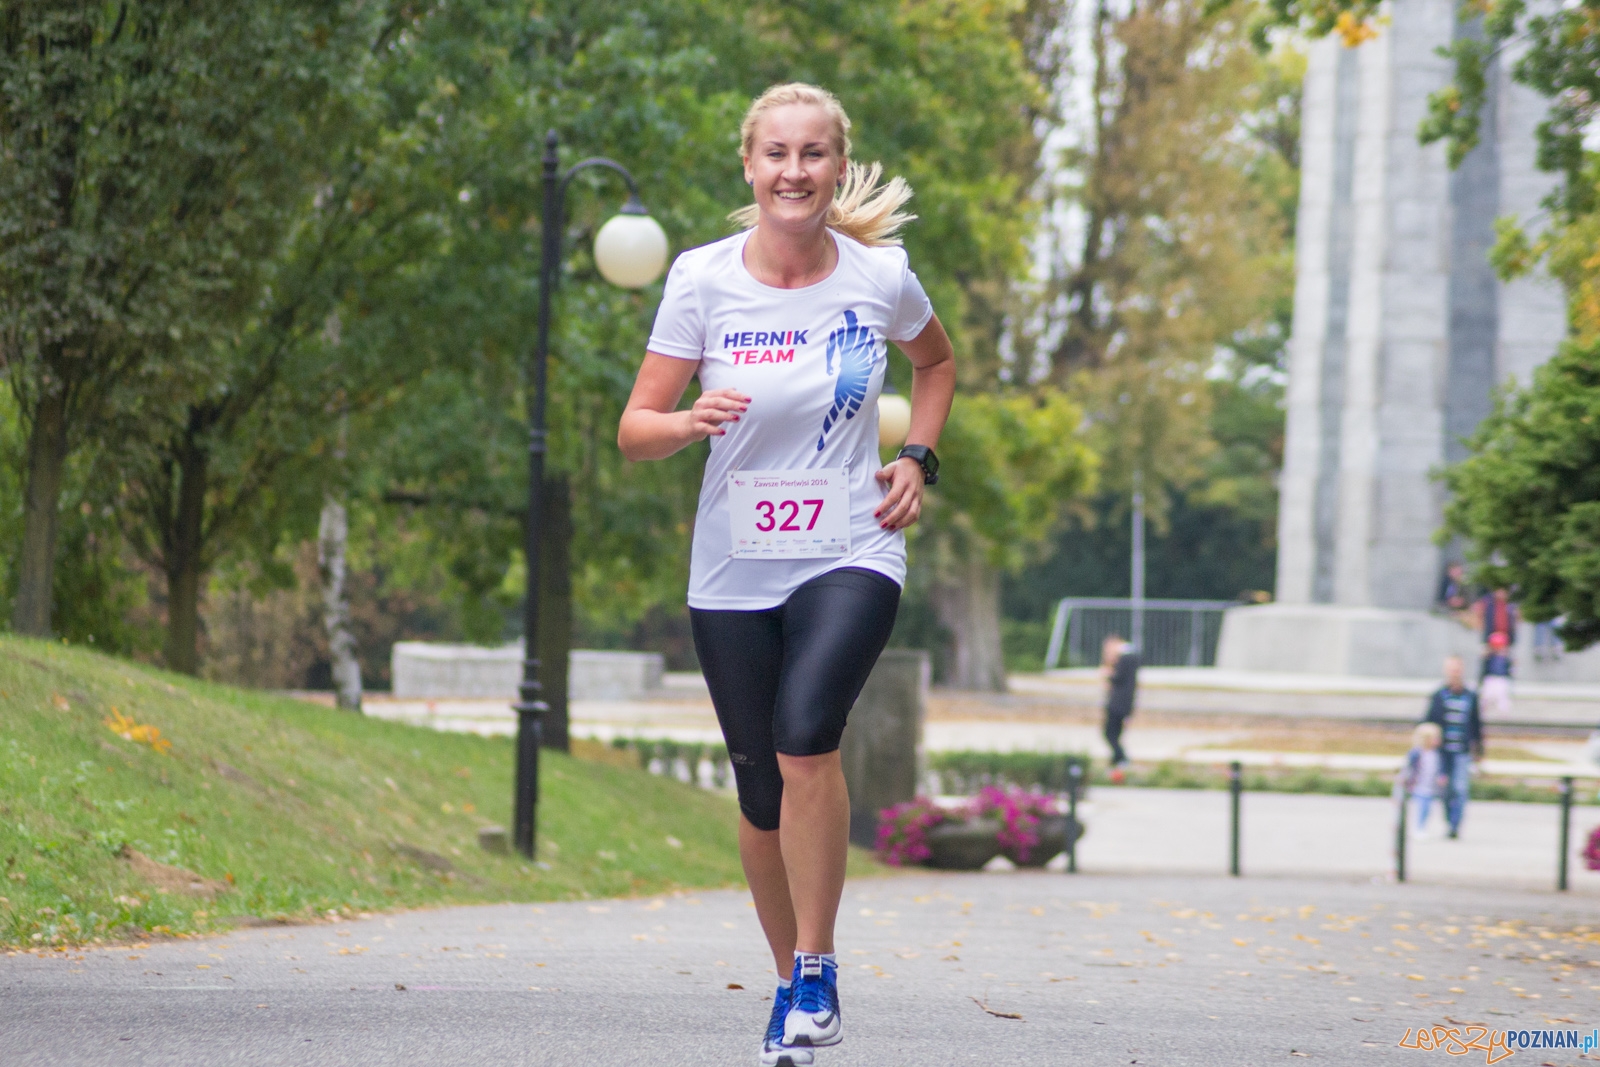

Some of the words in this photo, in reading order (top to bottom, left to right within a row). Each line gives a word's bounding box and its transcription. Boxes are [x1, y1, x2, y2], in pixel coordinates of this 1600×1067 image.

[724, 329, 809, 349] HERNIK
[732, 349, 795, 365] TEAM
[755, 499, 824, 532] 327
